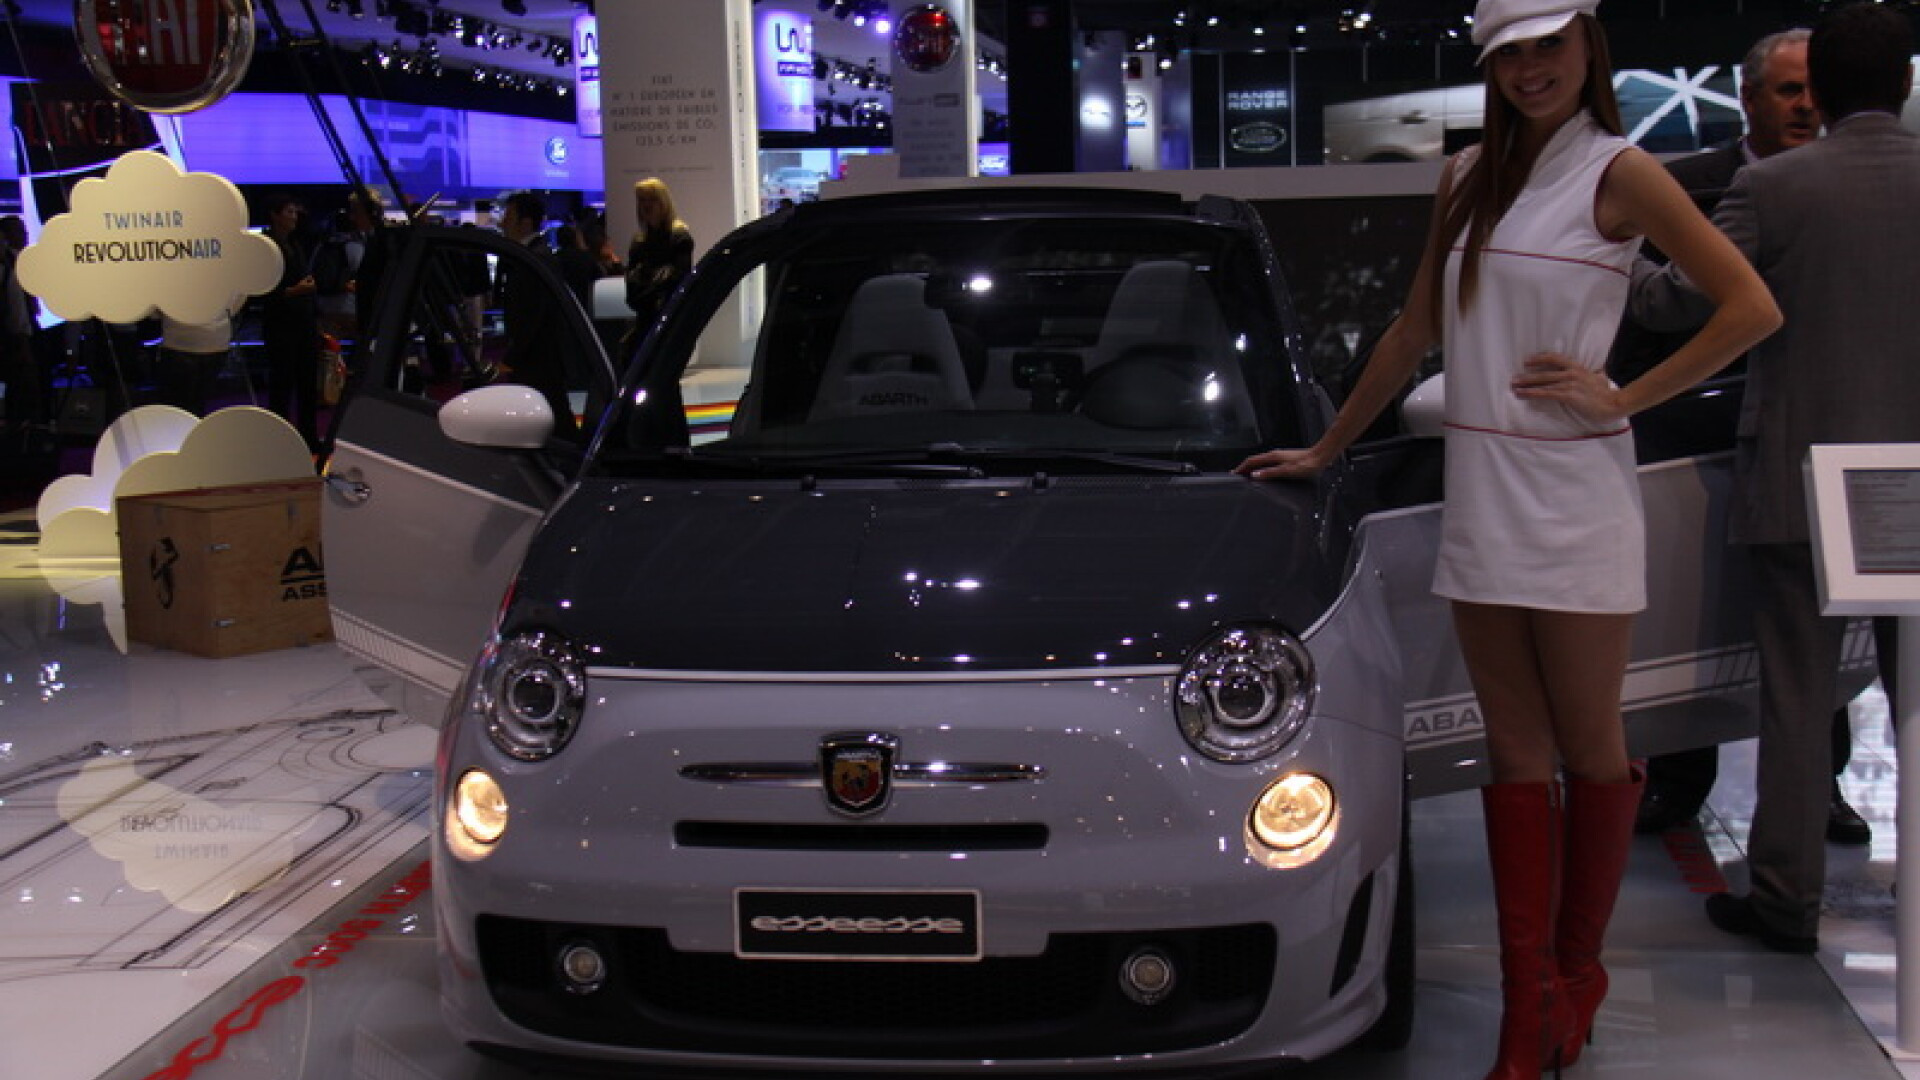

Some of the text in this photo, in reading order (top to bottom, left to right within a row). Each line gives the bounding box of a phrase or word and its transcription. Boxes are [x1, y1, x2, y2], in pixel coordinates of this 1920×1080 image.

[104, 210, 184, 230] TWINAIR
[73, 238, 222, 264] REVOLUTIONAIR
[749, 915, 964, 934] esseesse
